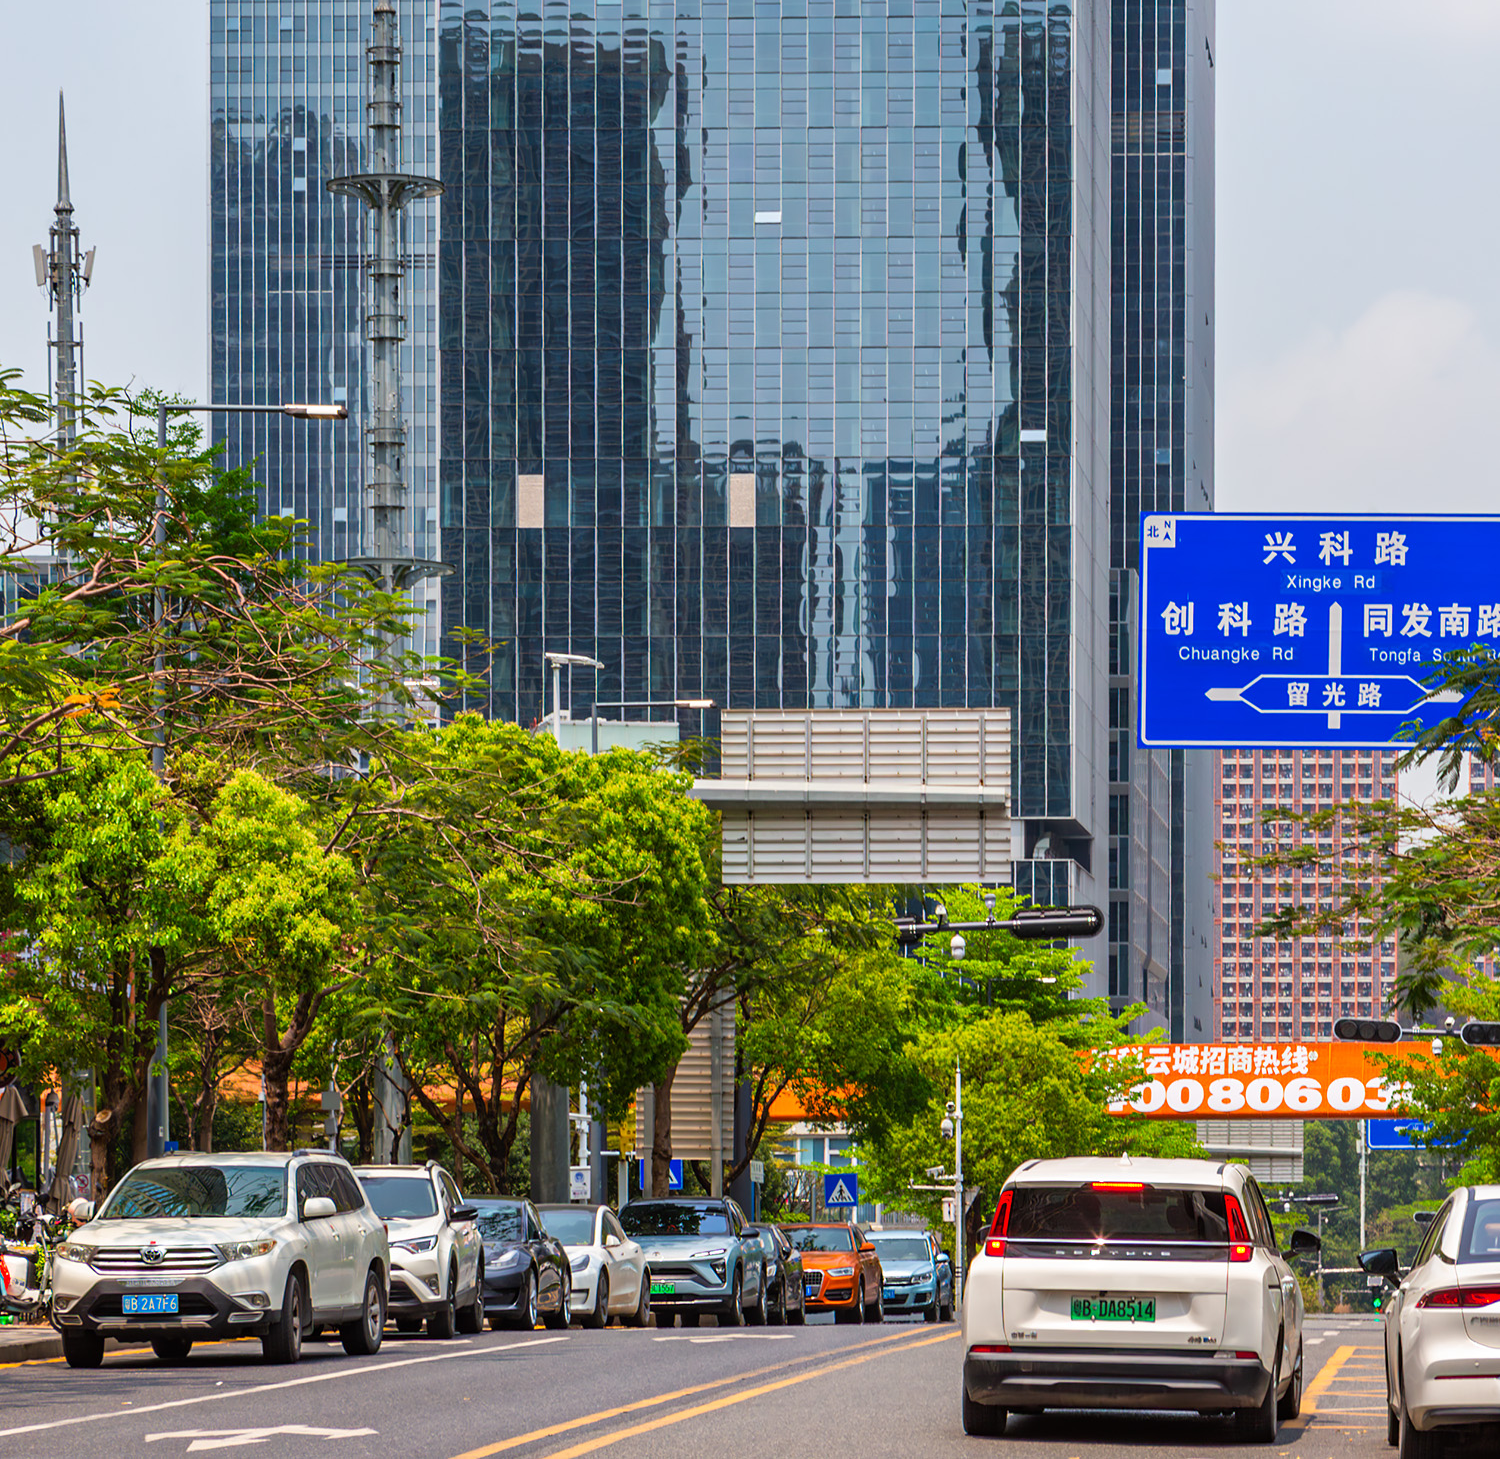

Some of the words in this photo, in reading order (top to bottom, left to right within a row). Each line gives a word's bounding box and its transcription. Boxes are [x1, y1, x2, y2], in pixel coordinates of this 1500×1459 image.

[1147, 525, 1159, 538] 北
[1164, 520, 1171, 529] N
[1263, 531, 1409, 566] 兴科路
[1286, 575, 1342, 593] Xingke
[1354, 575, 1375, 589] Rd
[1161, 601, 1308, 637] 创科路
[1363, 603, 1500, 638] 同发南路
[1178, 646, 1260, 664] Chuangke
[1272, 646, 1294, 661] Rd
[1369, 648, 1421, 665] Tongfa
[1287, 682, 1382, 707] 留光路
